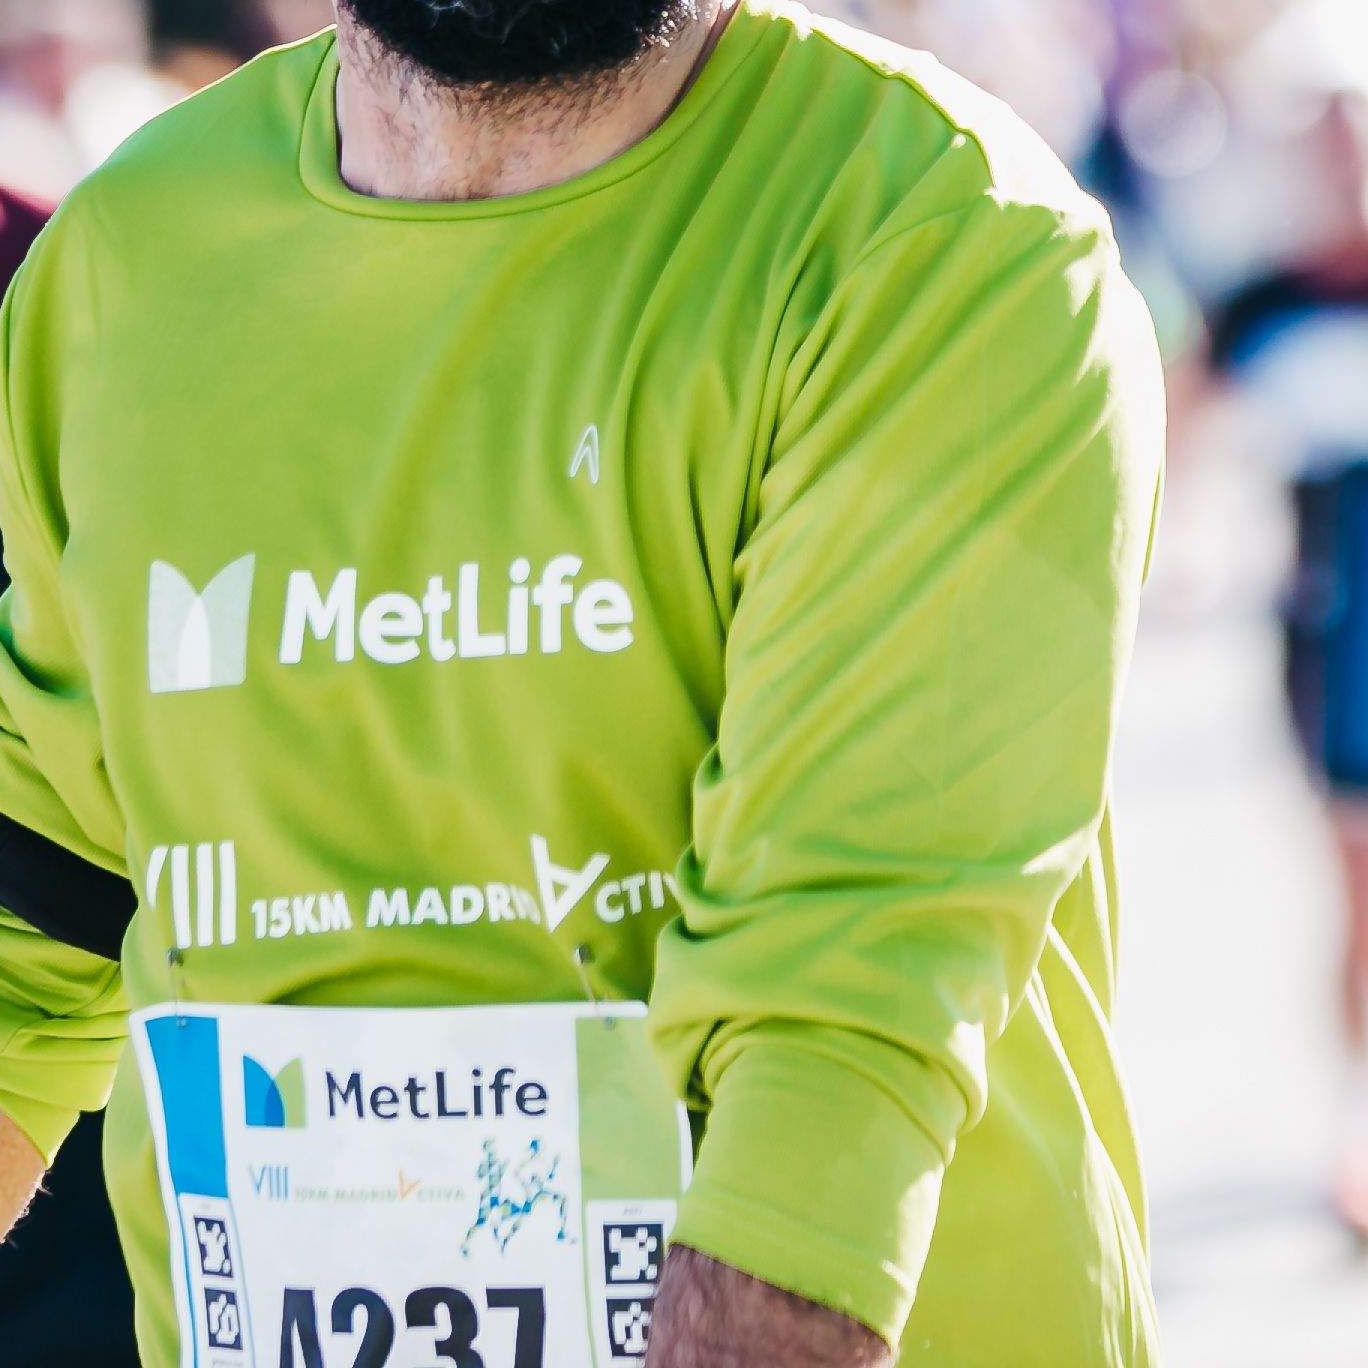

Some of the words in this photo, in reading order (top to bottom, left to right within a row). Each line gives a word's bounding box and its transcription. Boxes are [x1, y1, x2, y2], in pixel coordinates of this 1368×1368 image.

[278, 553, 634, 665] MetLife
[250, 889, 354, 939] 15KM
[325, 1066, 549, 1121] MetLife
